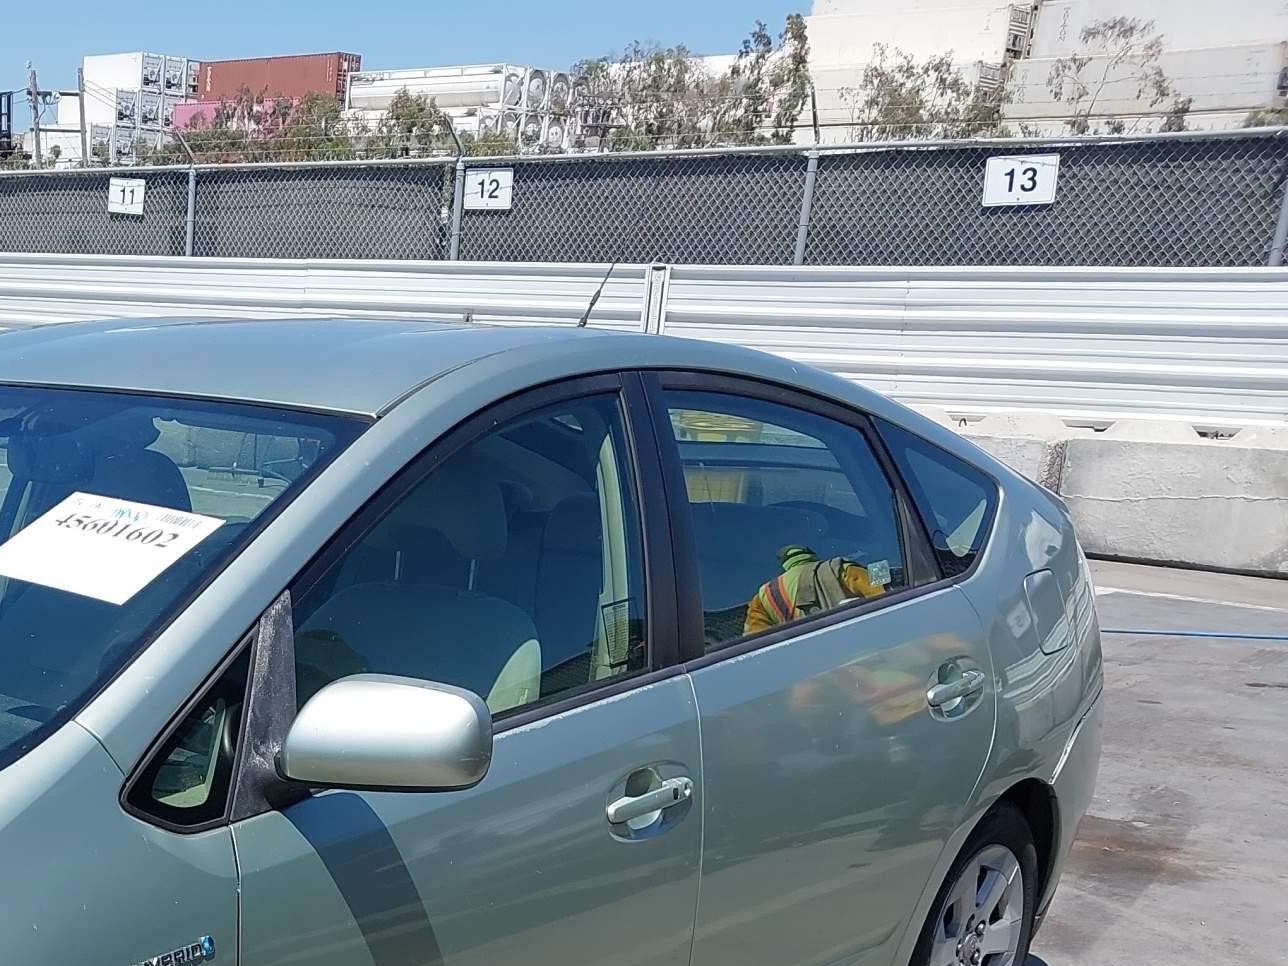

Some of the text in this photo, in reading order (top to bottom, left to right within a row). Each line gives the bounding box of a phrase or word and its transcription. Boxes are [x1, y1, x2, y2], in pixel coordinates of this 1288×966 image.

[477, 178, 500, 199] 12
[1004, 167, 1038, 193] 13
[120, 187, 135, 205] 11
[55, 513, 180, 547] 45601602
